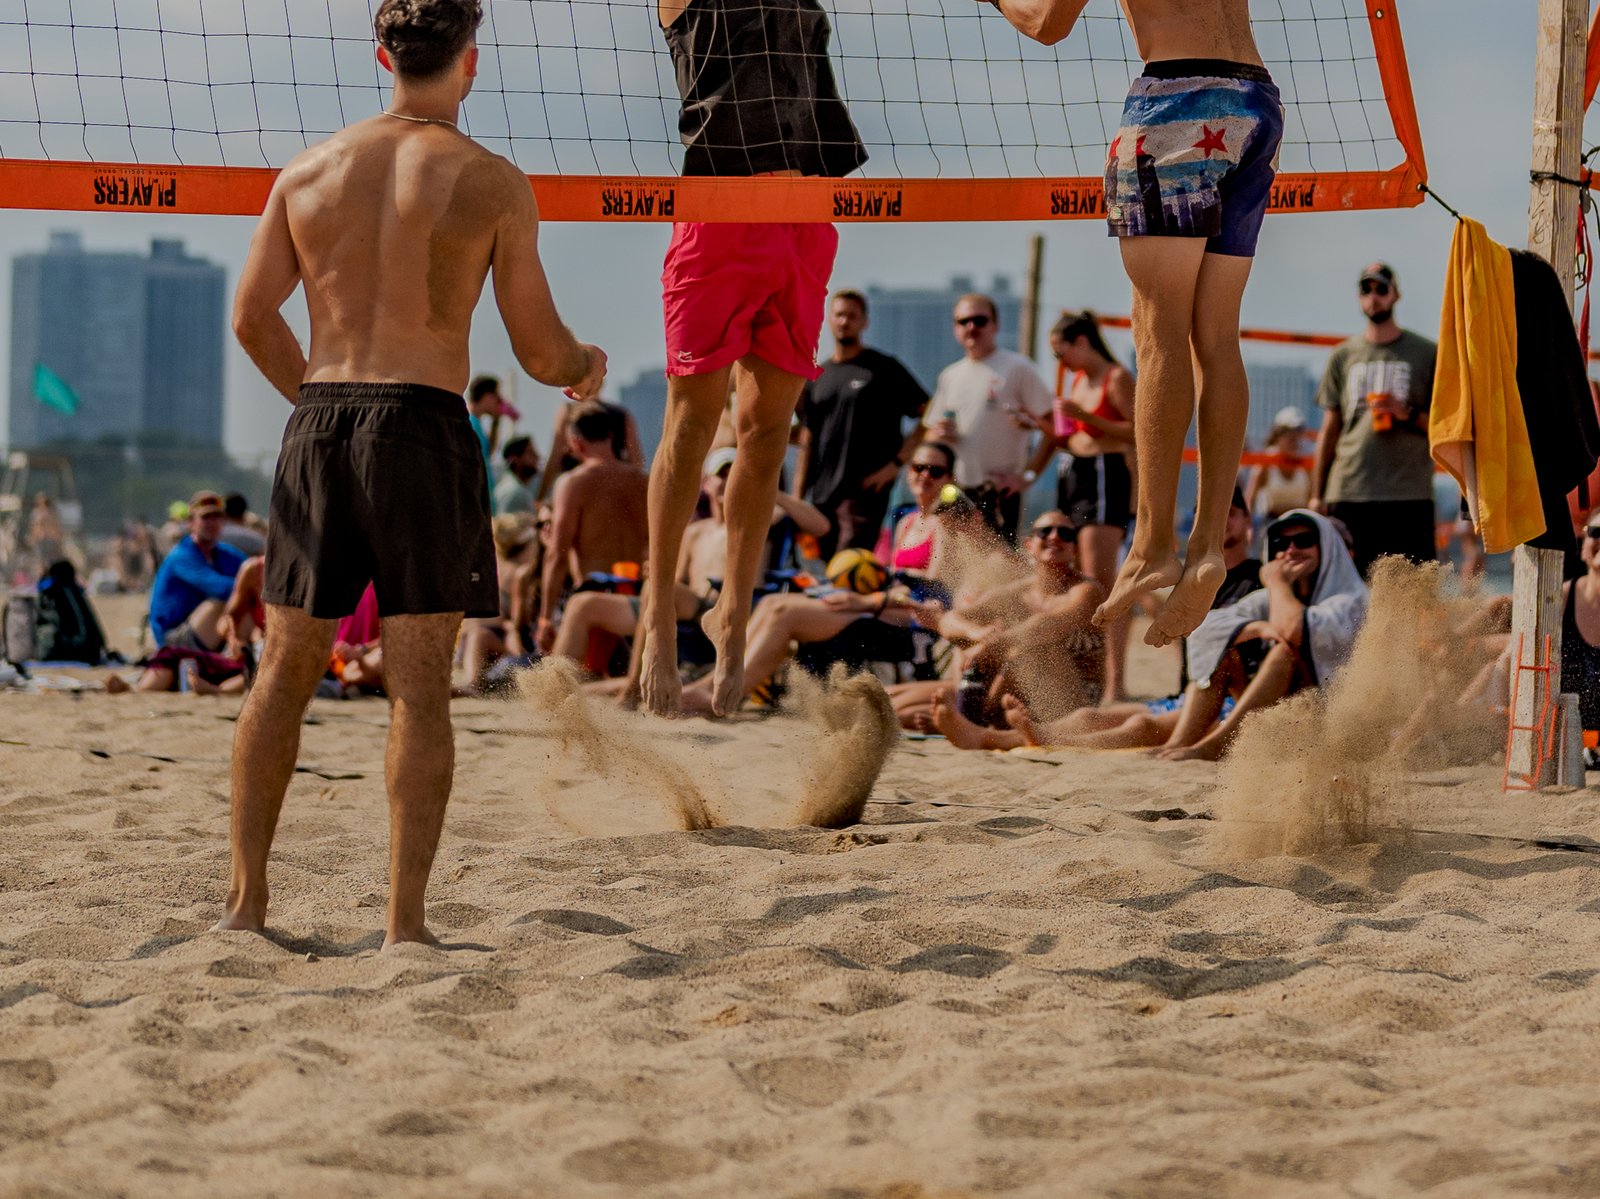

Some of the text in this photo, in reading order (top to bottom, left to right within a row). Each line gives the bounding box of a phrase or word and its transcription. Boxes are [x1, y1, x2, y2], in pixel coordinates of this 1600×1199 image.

[94, 176, 176, 207] PLAYERS
[602, 189, 675, 216] PLAYERS
[833, 190, 902, 216] PLAYERS
[1051, 189, 1106, 215] LAYERS
